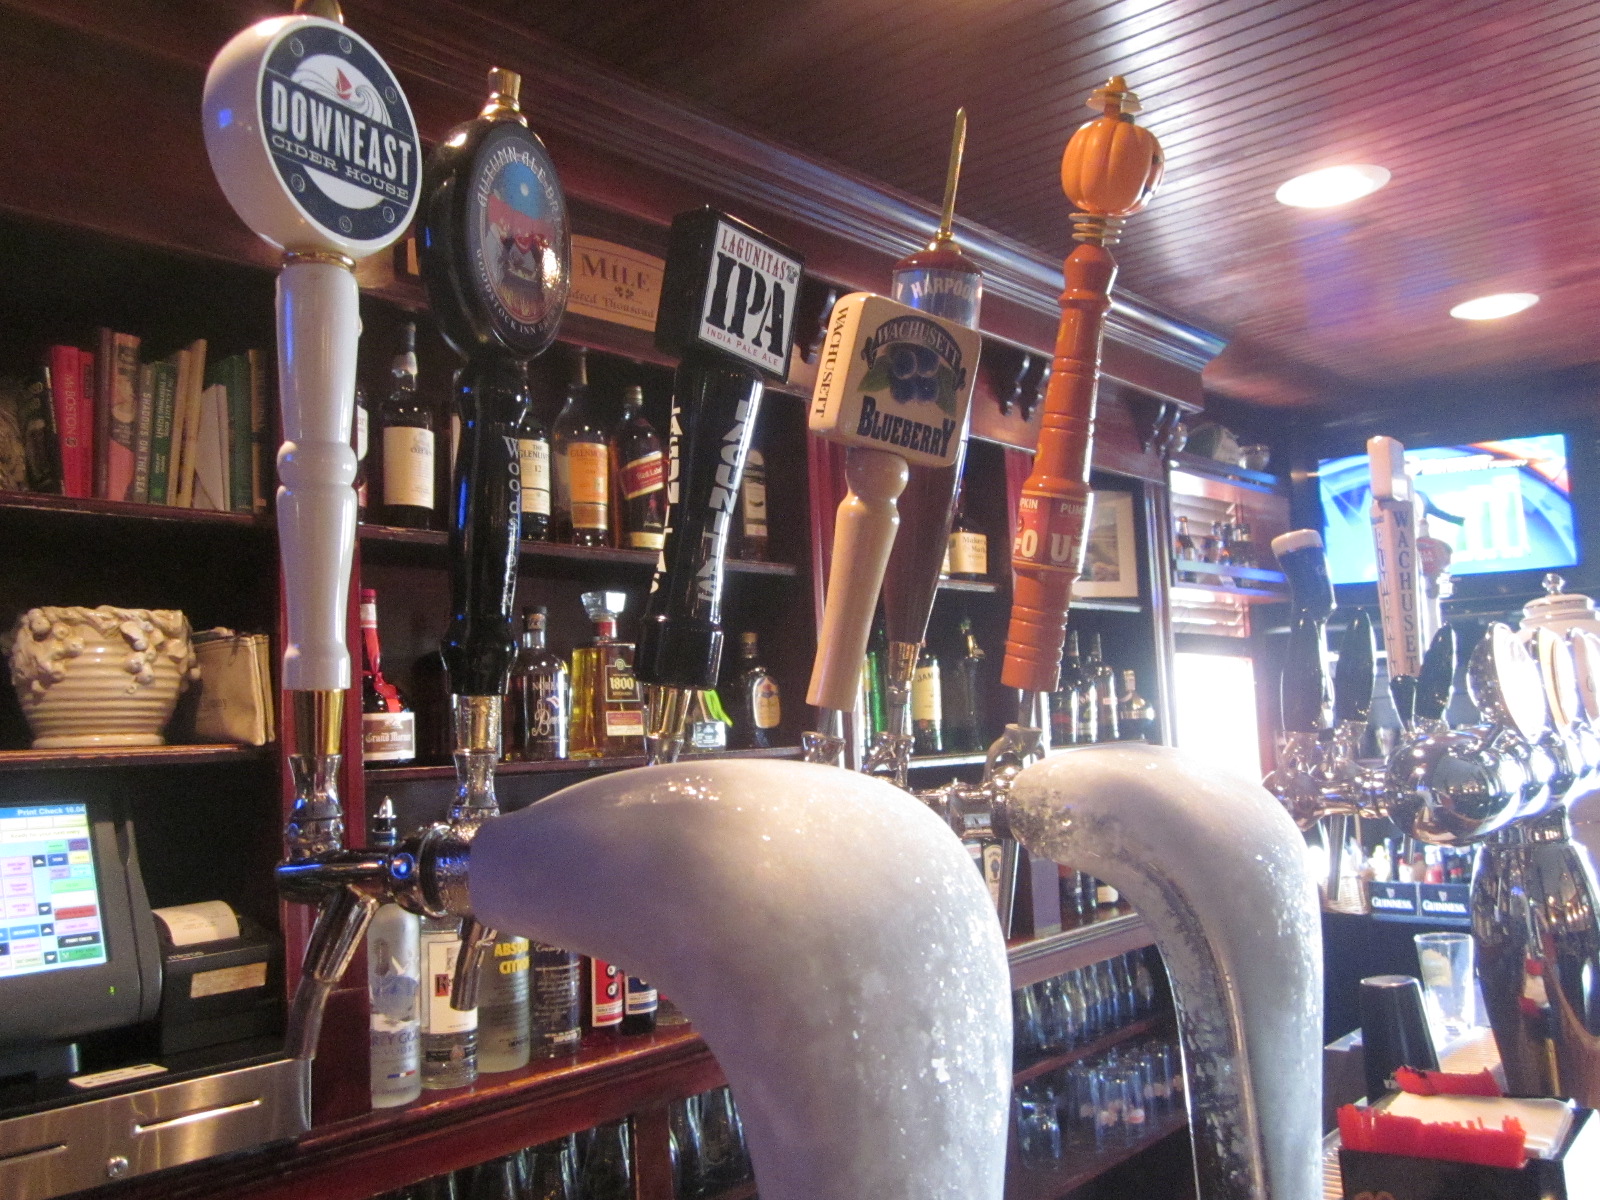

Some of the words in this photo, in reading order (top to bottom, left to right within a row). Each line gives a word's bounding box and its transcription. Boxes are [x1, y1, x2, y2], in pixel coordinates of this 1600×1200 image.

[271, 80, 412, 186] DOWNEAST
[271, 135, 338, 171] CIDER
[346, 166, 410, 201] HOUSE
[720, 228, 788, 281] LAGUNITAS
[705, 251, 786, 358] IPA
[706, 327, 732, 345] INDIA
[735, 340, 759, 357] PALE
[761, 353, 780, 367] ALE
[815, 305, 850, 419] WACHUSETT
[877, 320, 960, 367] WACHUSETT
[65, 390, 78, 436] BOSTON
[140, 392, 151, 437] SHADOWS
[856, 395, 957, 458] BLUEBERRY
[137, 455, 147, 473] THE
[140, 439, 149, 453] ON
[135, 475, 146, 494] SEA
[609, 676, 635, 691] 1800
[17, 808, 37, 817] Print
[38, 807, 64, 816] Check
[1371, 896, 1415, 910] GUINNESS
[1422, 899, 1467, 914] GUINNESS
